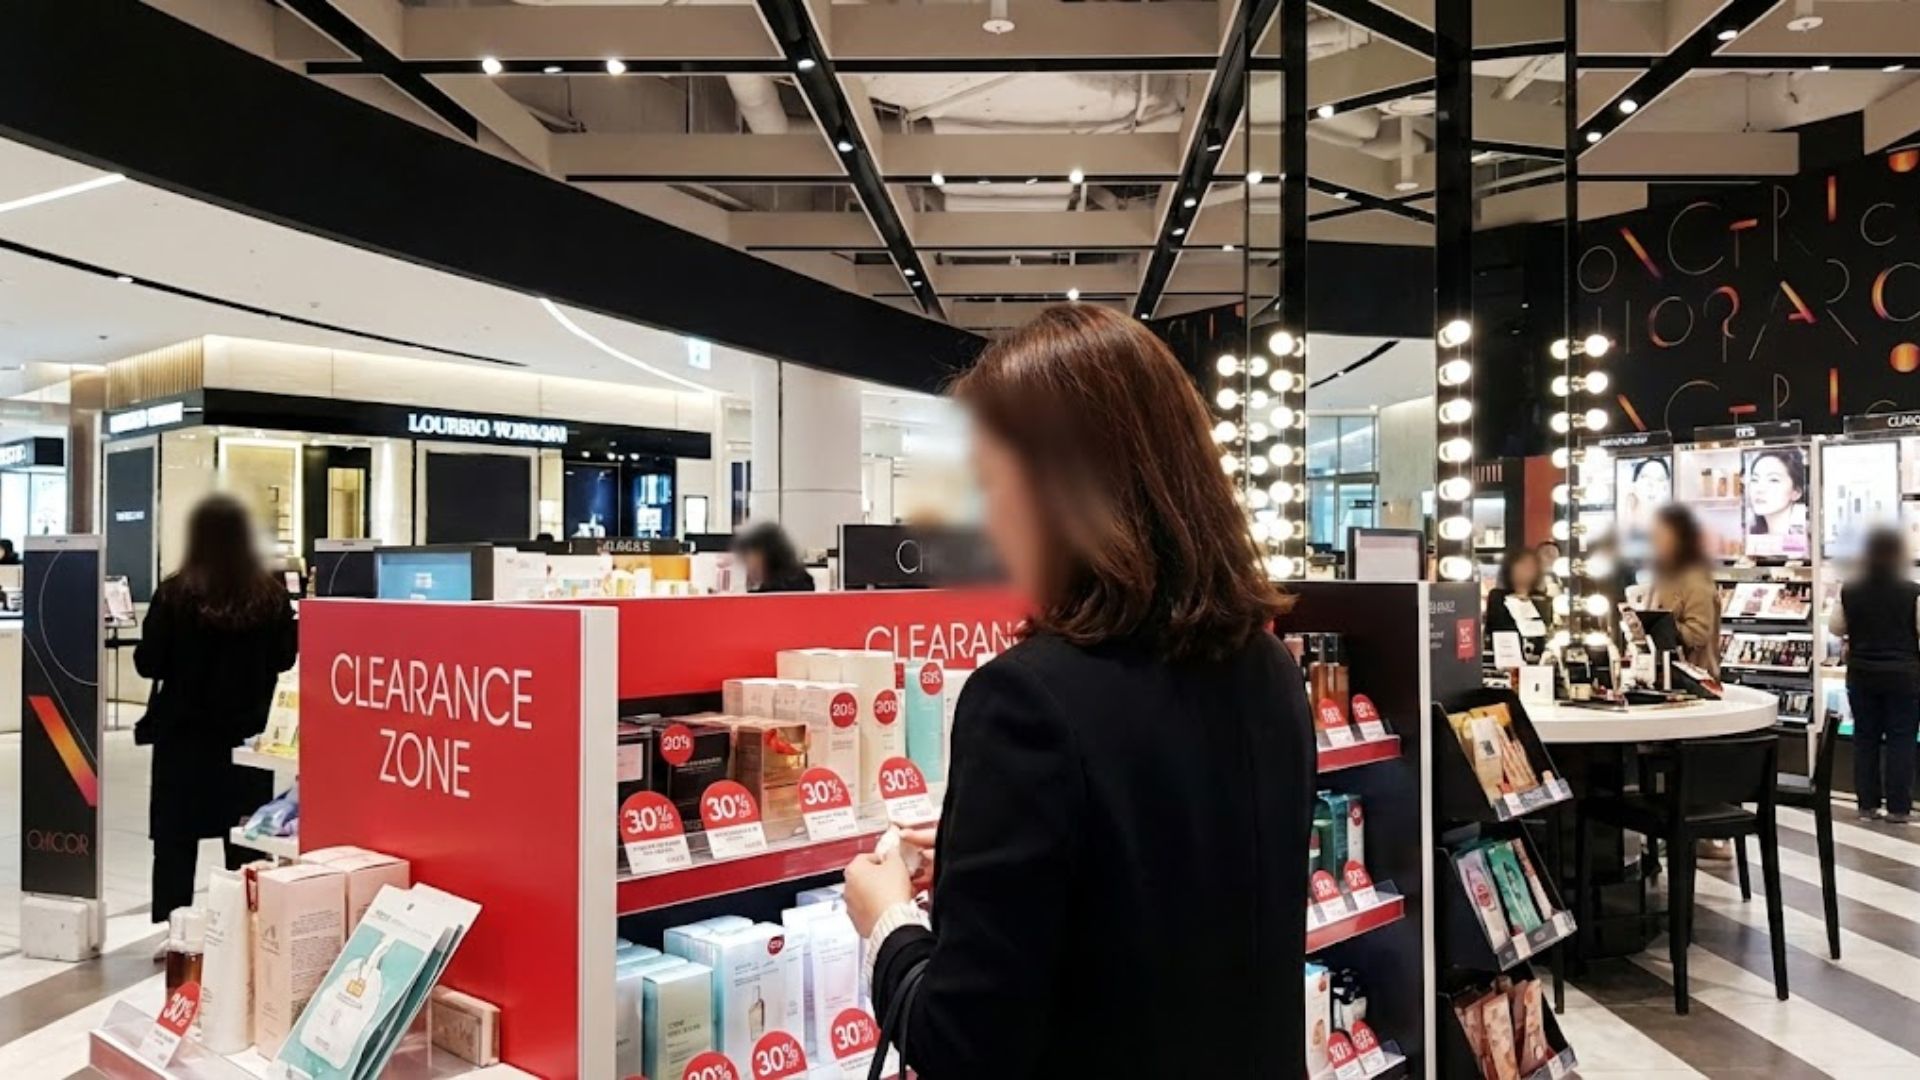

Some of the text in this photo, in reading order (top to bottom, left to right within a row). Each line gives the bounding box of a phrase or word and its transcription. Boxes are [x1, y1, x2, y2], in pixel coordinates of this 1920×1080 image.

[331, 653, 533, 730] CLEARANCE
[379, 728, 471, 798] ZONE
[802, 780, 842, 805] 30%
[881, 767, 919, 792] 30%
[624, 804, 673, 834] 30%
[706, 793, 750, 822] 30%
[162, 992, 196, 1022] 30%
[835, 1017, 873, 1050] 30%
[756, 1040, 798, 1076] 30%
